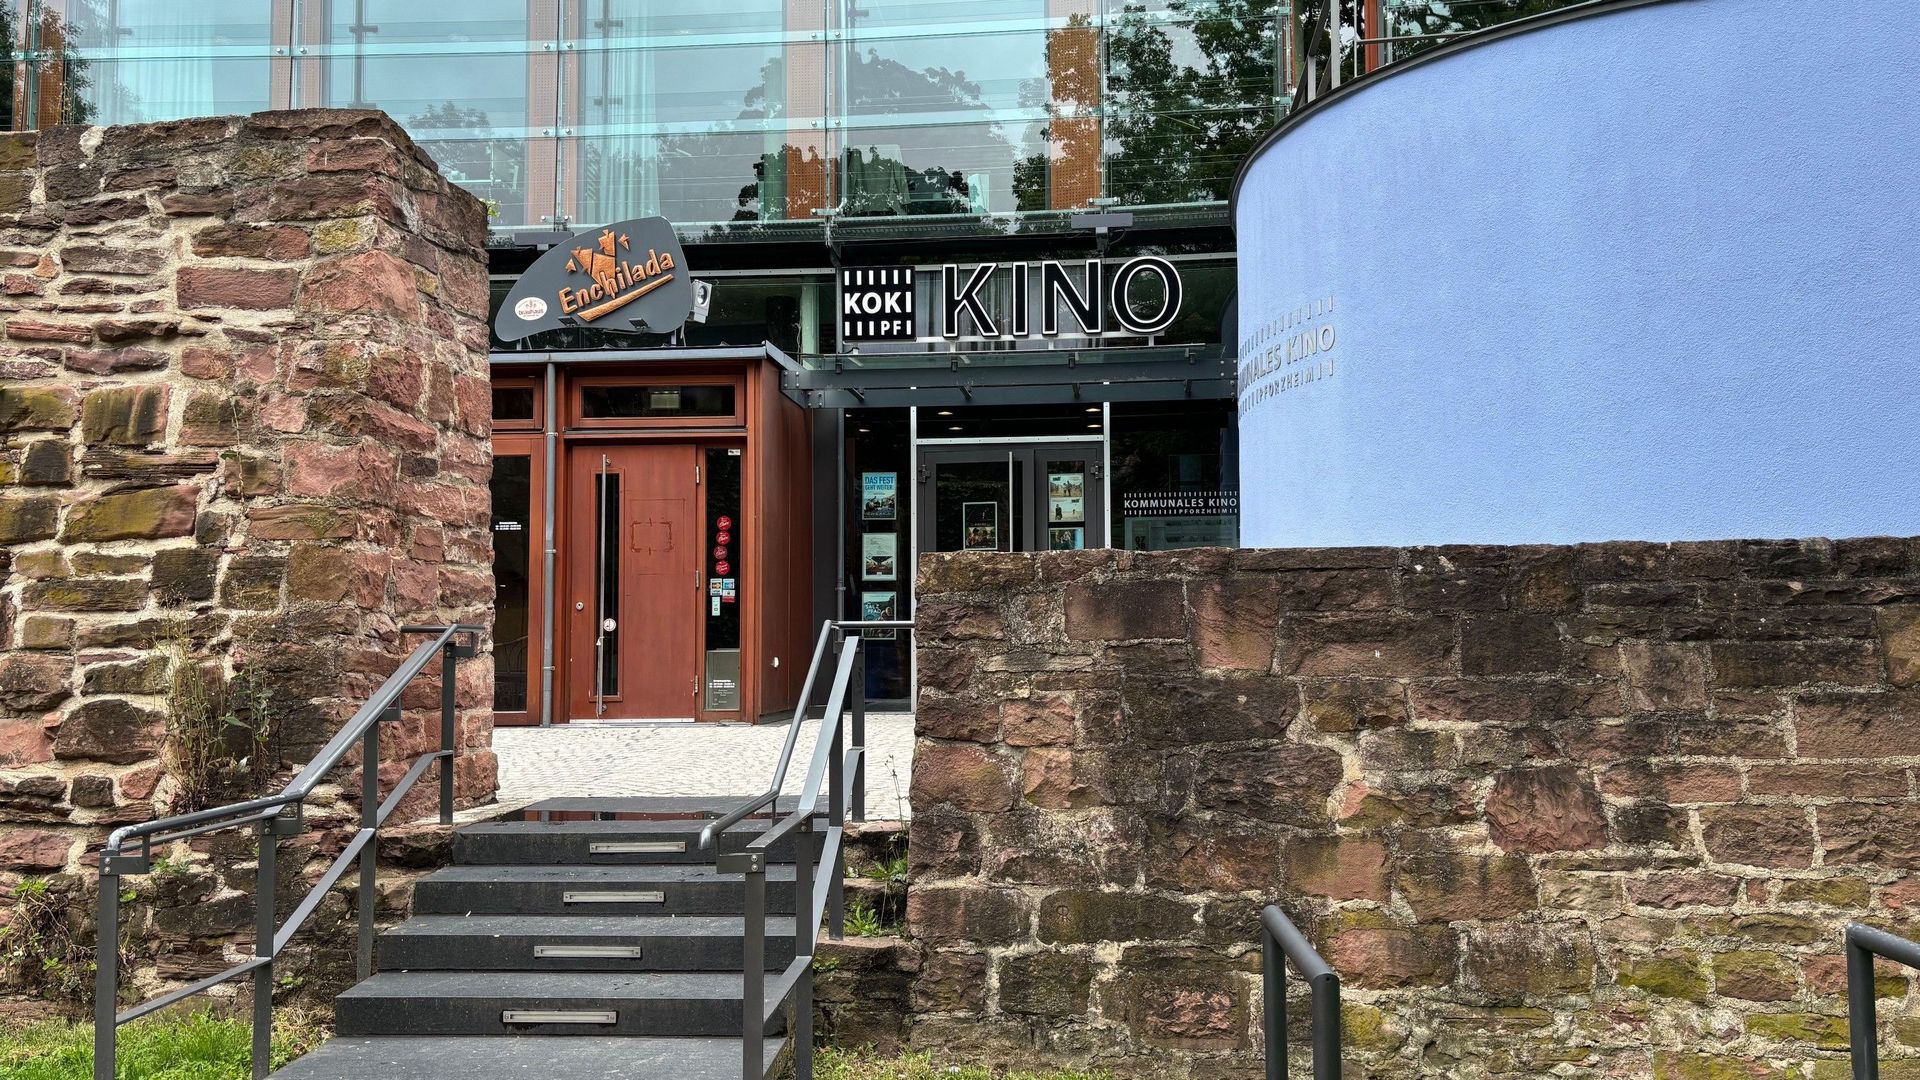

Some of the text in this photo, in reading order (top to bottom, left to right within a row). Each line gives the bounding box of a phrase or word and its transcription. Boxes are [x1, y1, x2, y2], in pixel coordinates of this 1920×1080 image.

[557, 248, 675, 314] Enchilada
[942, 256, 1183, 338] KINO
[844, 292, 912, 315] KOKI
[1286, 324, 1335, 365] KINO
[864, 476, 894, 485] DAS FEST
[1124, 498, 1237, 509] KOMMUNALES KINO
